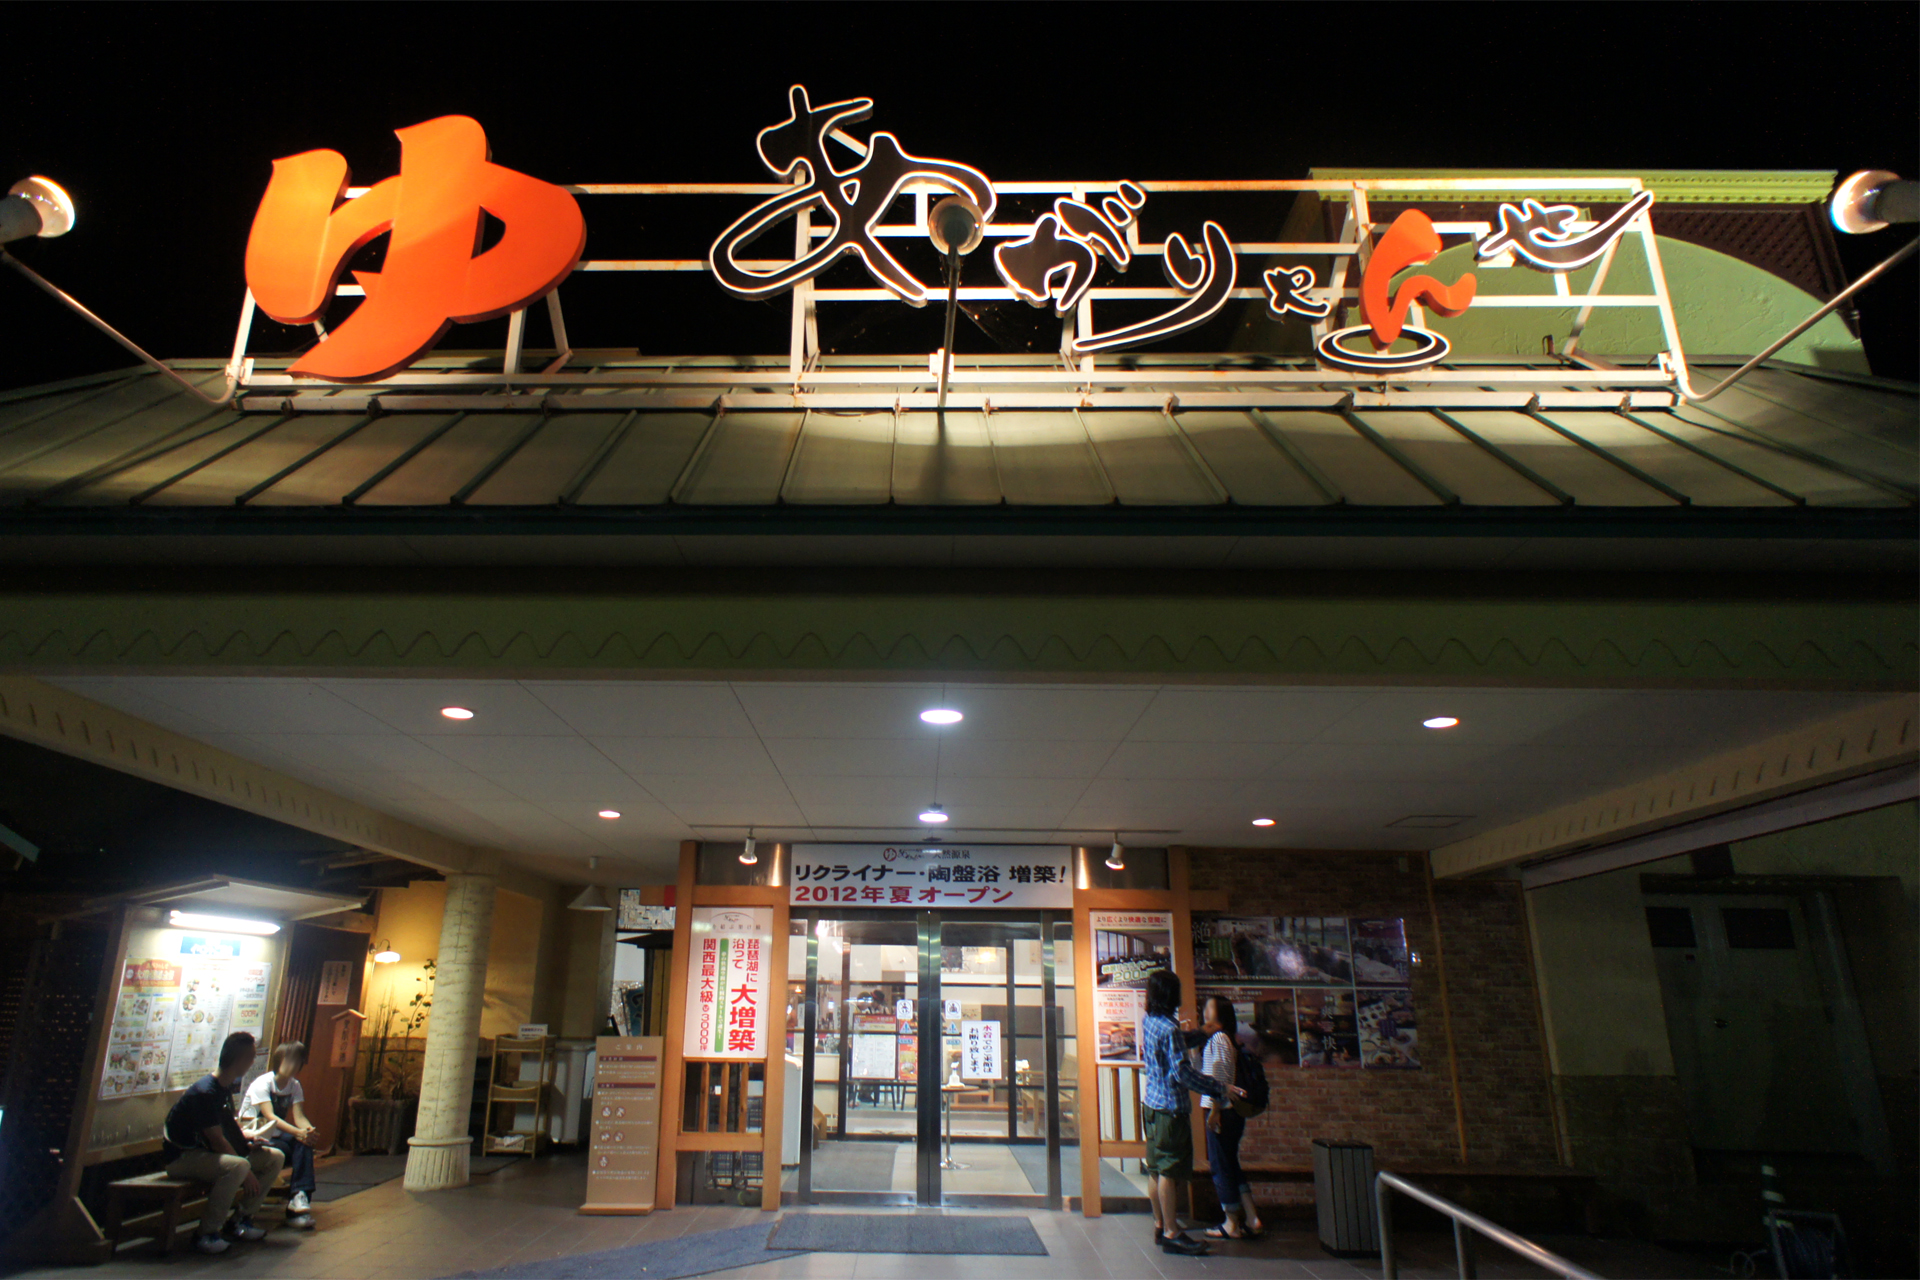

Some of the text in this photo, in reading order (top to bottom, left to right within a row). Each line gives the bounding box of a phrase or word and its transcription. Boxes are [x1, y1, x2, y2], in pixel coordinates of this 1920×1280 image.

[699, 938, 717, 1004] 関西最大級
[732, 938, 745, 970] 沿って
[746, 938, 760, 983] 琵琶湖に
[728, 983, 758, 1052] 大増築
